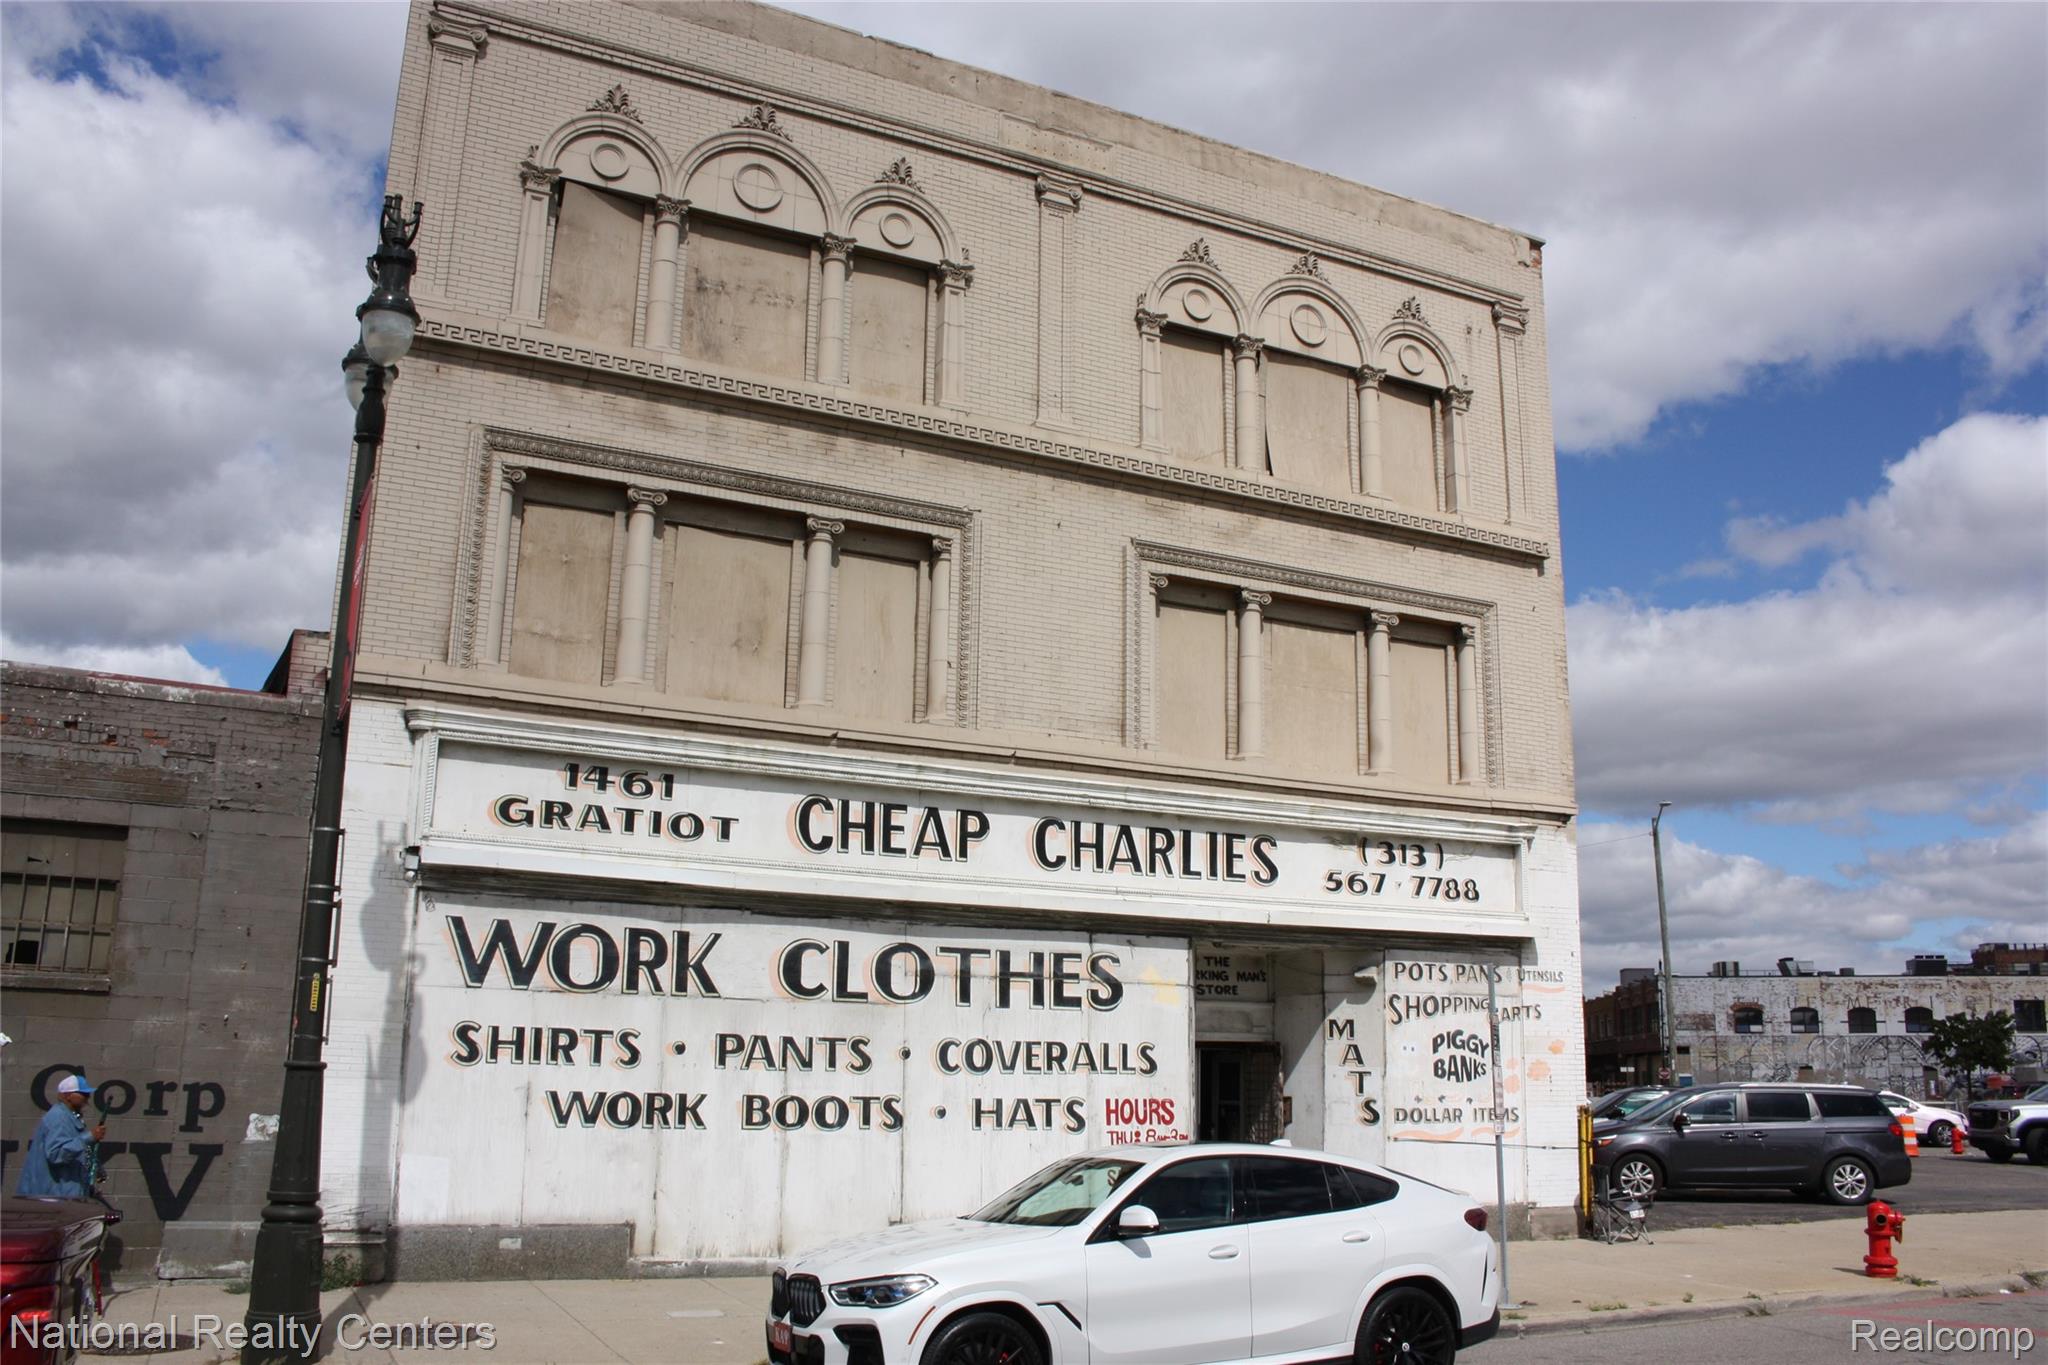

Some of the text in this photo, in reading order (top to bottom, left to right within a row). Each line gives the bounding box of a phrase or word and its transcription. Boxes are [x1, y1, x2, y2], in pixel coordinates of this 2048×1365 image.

[564, 762, 674, 801] 1461
[495, 794, 739, 843] GRATIOT
[794, 793, 1280, 888] CHEAP CHARLIES
[1357, 836, 1444, 871] (313)
[444, 915, 1124, 1012] WORK CLOTHES
[1203, 955, 1230, 967] THE
[1517, 967, 1564, 983] UTENSILS
[1195, 983, 1239, 996] STORE
[1388, 993, 1542, 1025] SHOPPING ARTS
[450, 1020, 1159, 1077] SHIRTS PANTS COVERALLS
[1432, 1028, 1490, 1059] PIGGY
[1326, 1018, 1381, 1127] MATS
[1432, 1054, 1487, 1083] BANKS
[30, 1063, 226, 1133] Corp
[545, 1090, 1087, 1135] WORK BOOTS HATS
[1105, 1097, 1175, 1126] HOURS
[1393, 1107, 1463, 1123] DOLLAR
